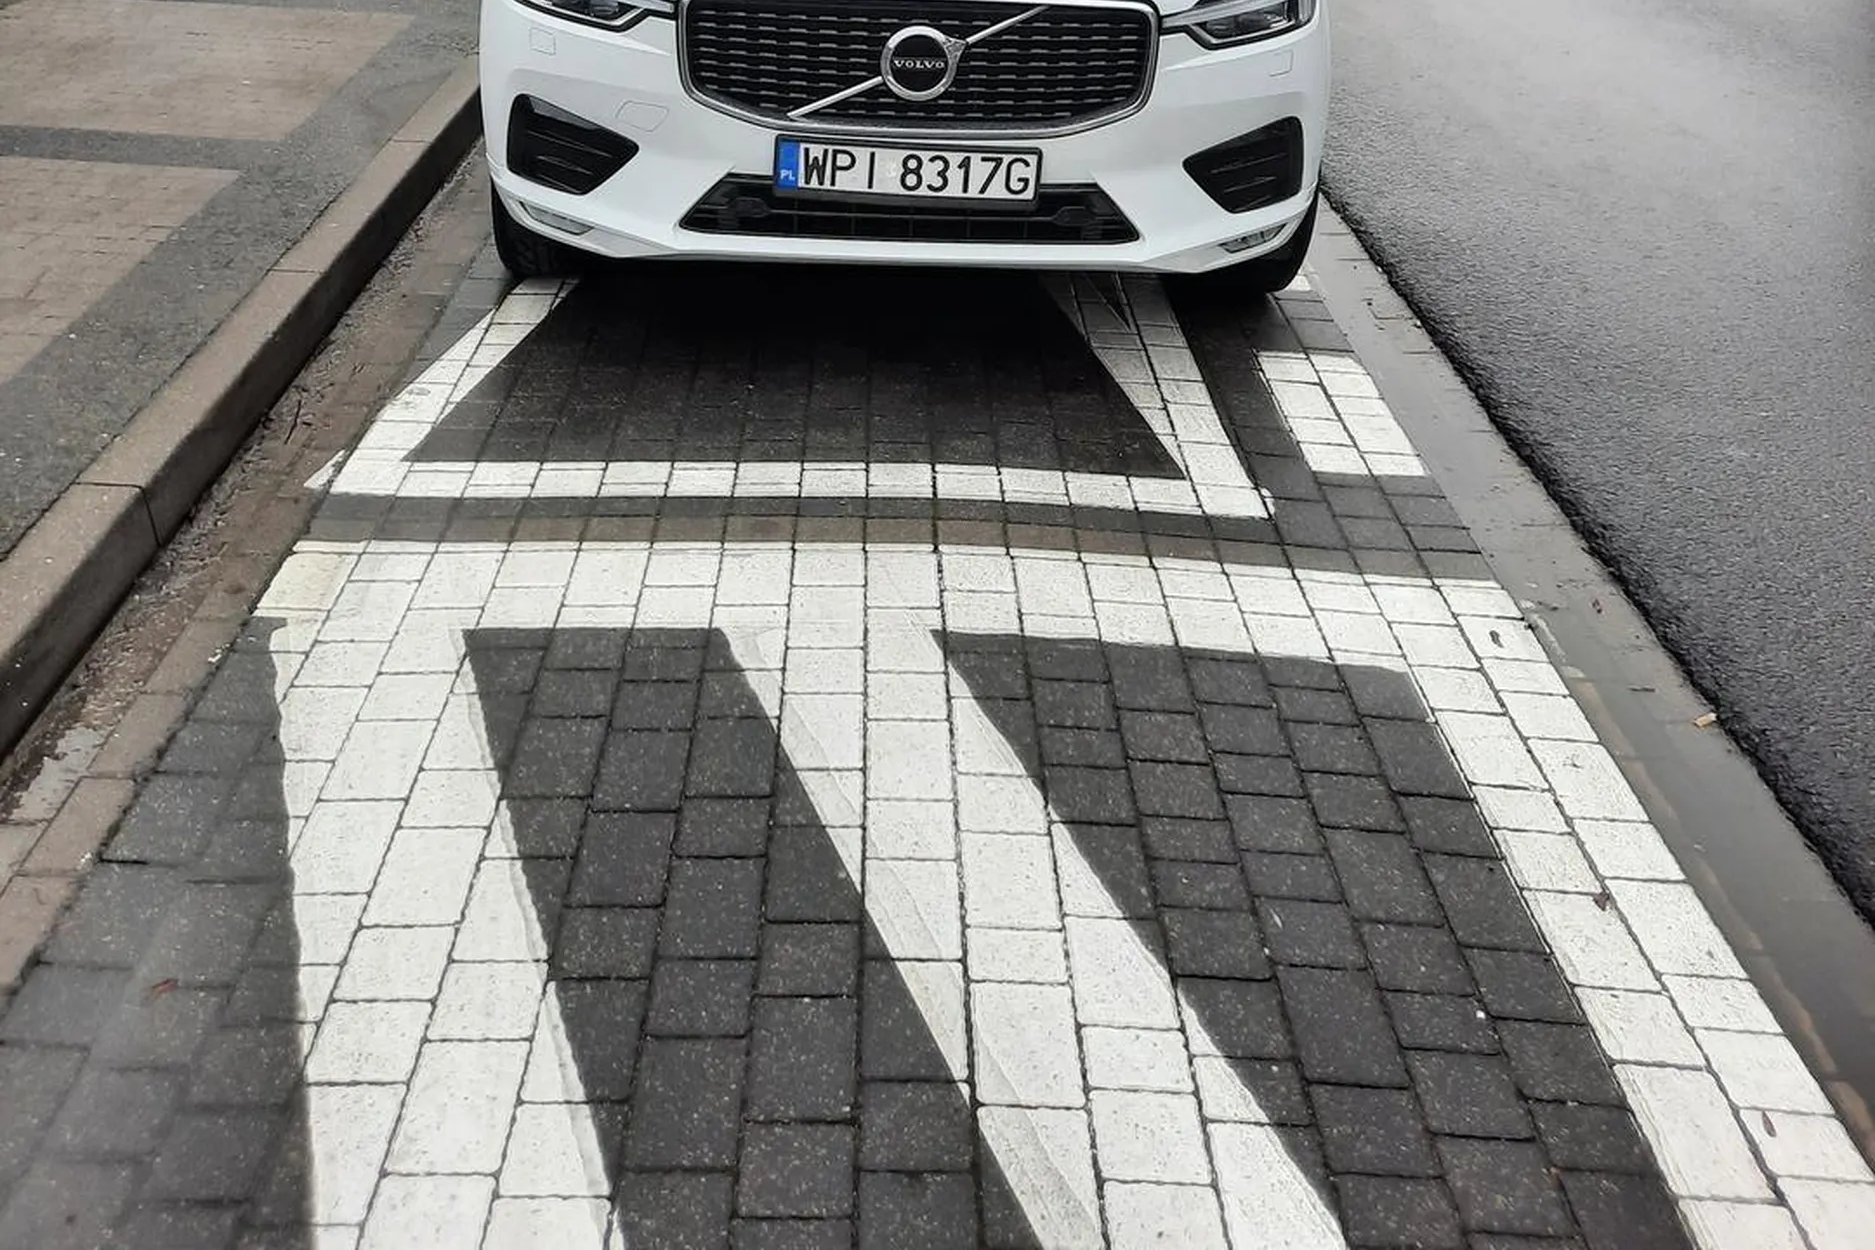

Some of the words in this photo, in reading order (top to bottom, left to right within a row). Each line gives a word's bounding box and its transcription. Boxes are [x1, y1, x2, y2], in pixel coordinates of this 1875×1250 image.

[893, 59, 946, 70] VOLVO
[780, 169, 796, 181] PL
[803, 147, 877, 189] WPI
[899, 153, 1031, 195] 8317G
